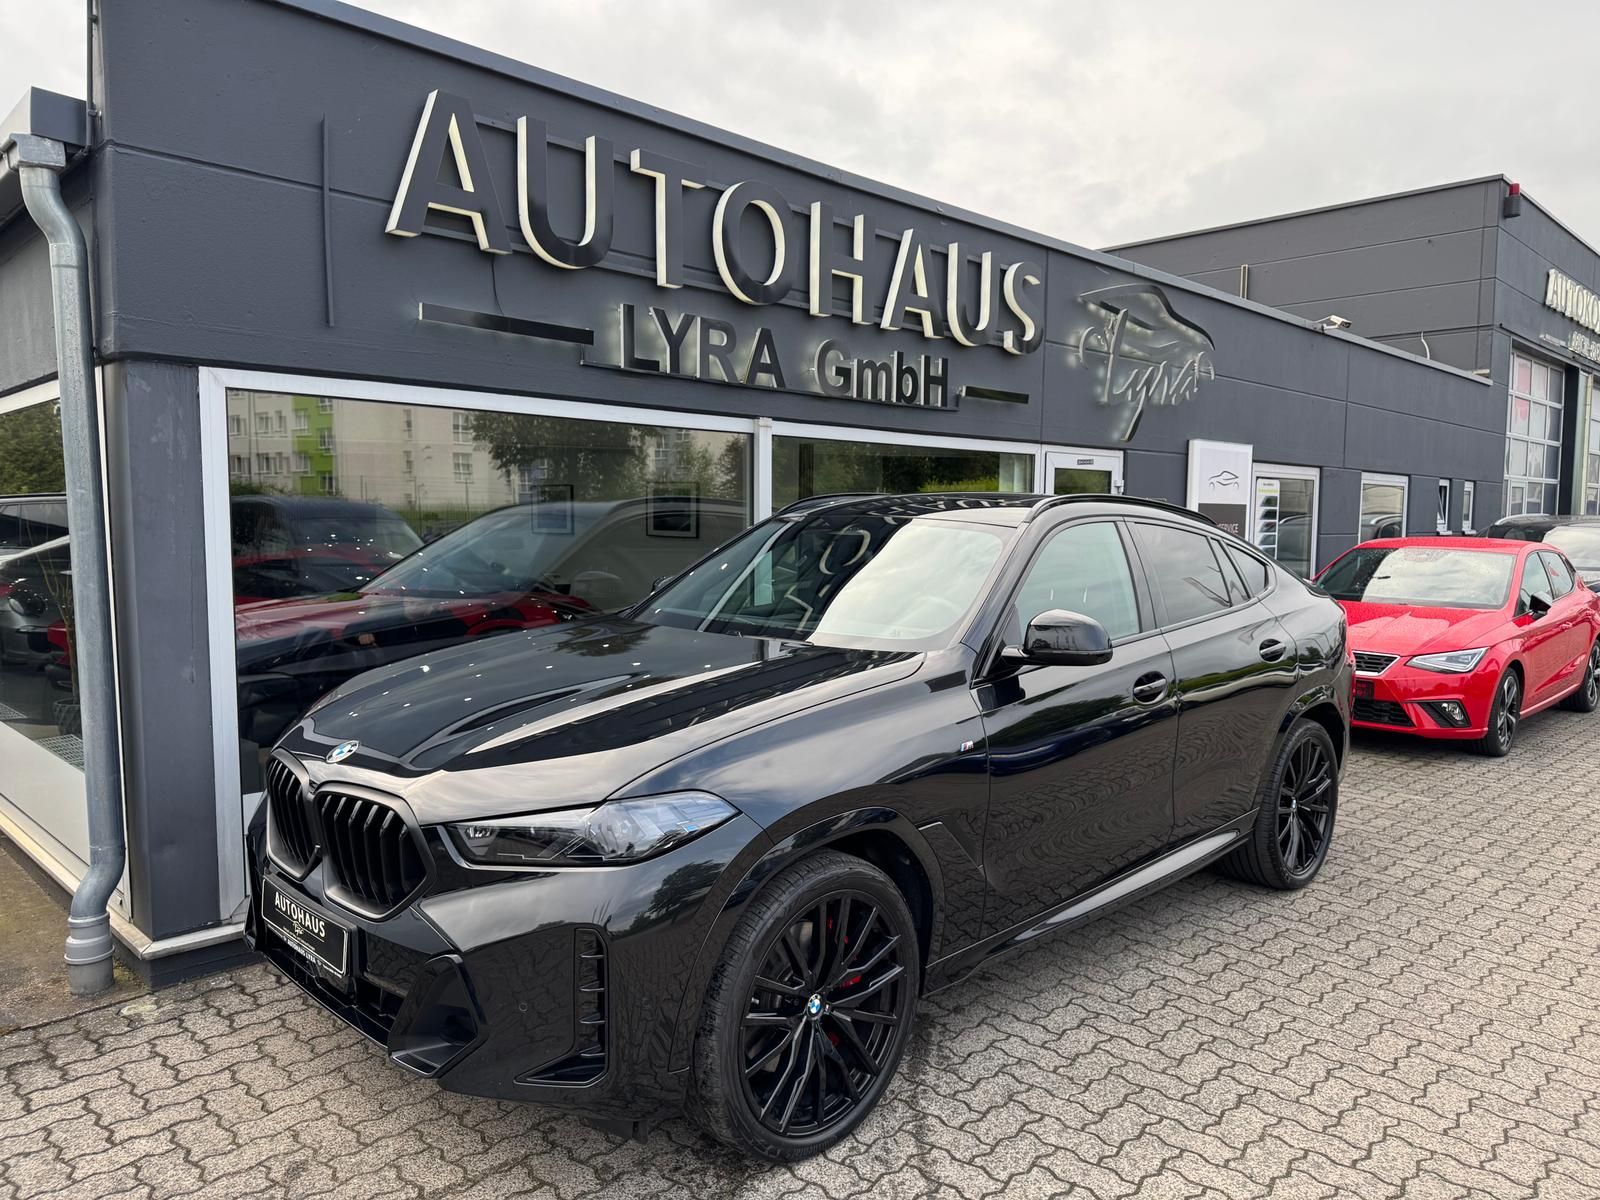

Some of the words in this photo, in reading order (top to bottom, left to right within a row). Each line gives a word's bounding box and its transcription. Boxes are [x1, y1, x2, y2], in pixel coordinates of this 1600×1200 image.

[385, 89, 1043, 356] AUTOHAUS
[1546, 269, 1600, 334] AUTOKO
[619, 303, 787, 389] LYRA
[814, 339, 948, 407] GmbH
[275, 892, 325, 938] AUTOHAUS
